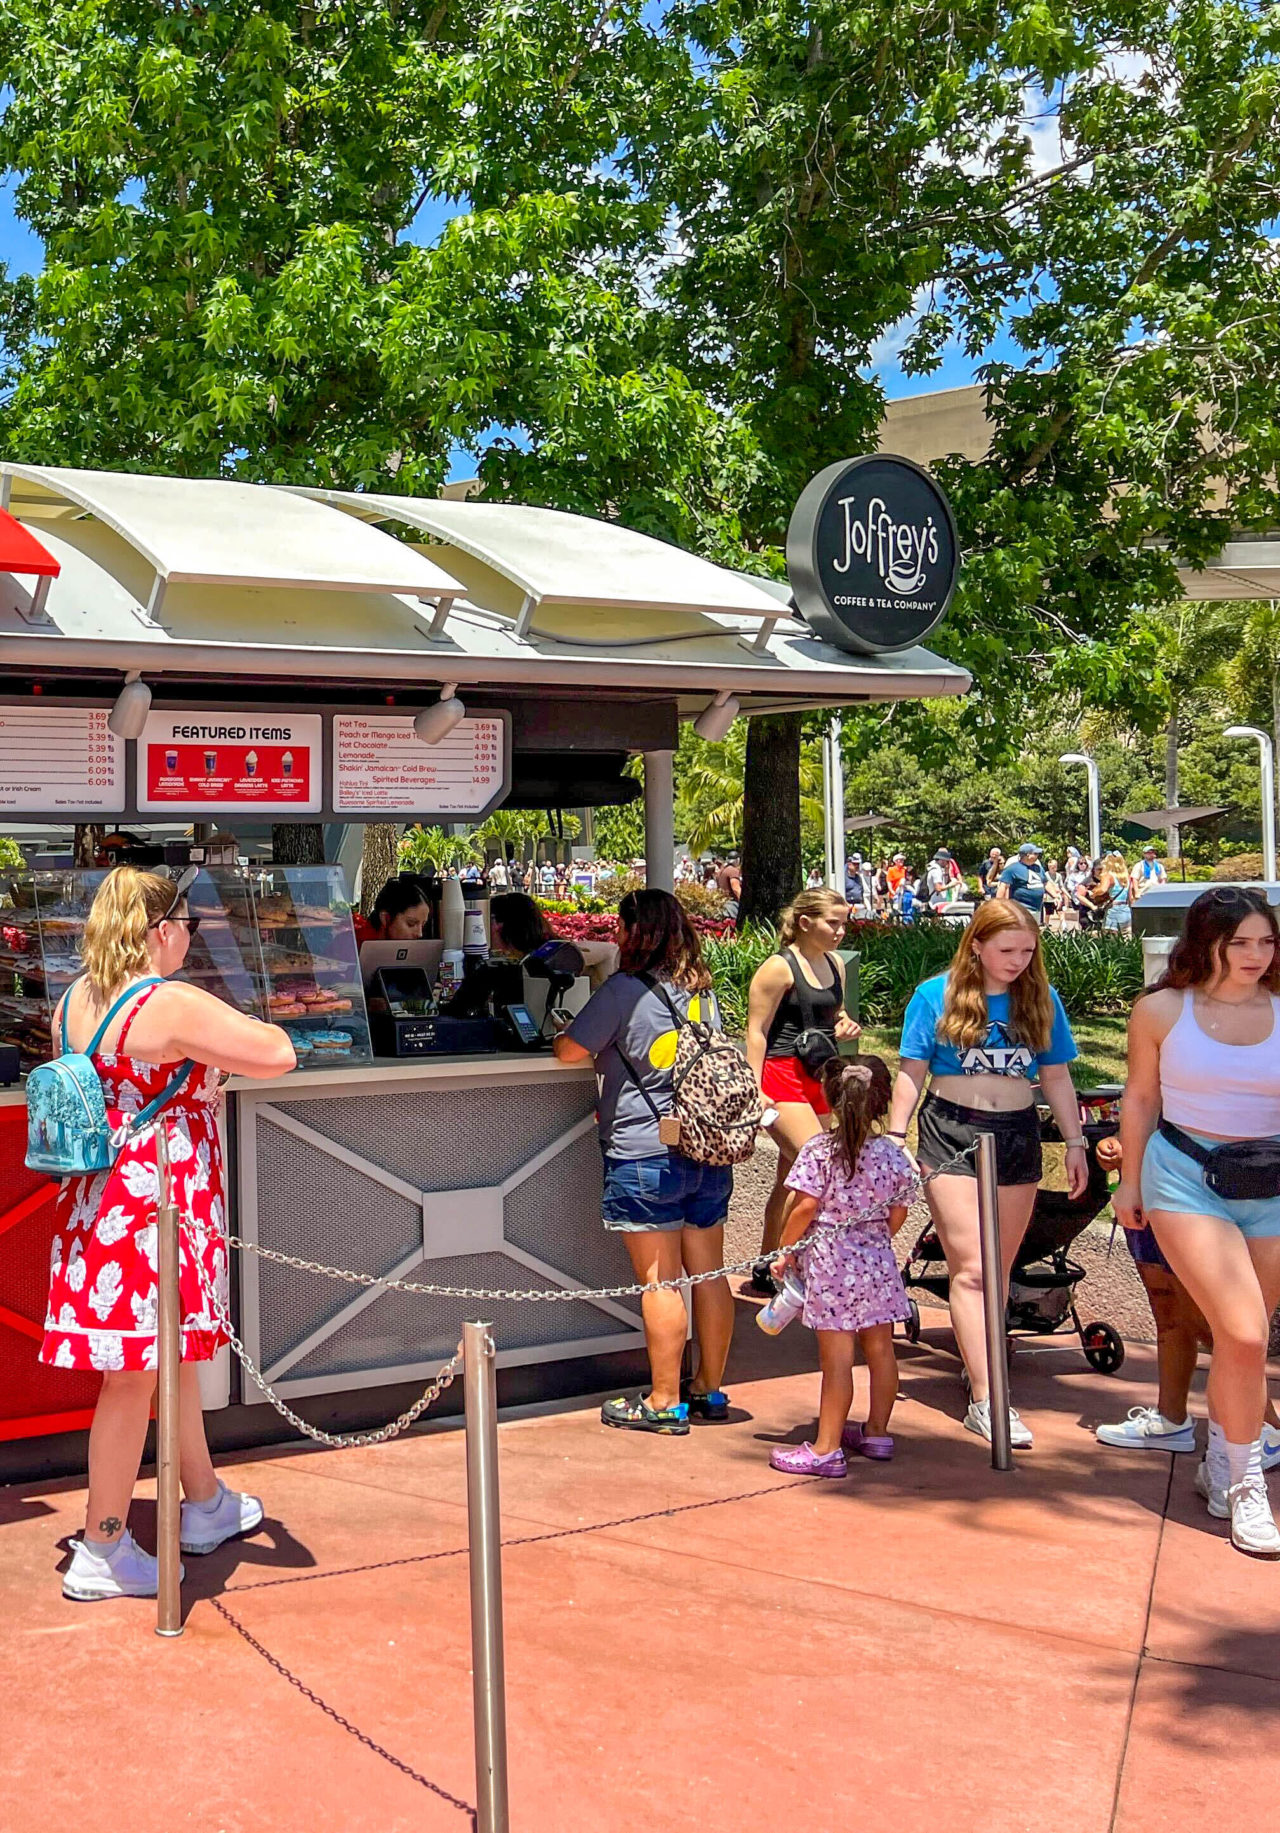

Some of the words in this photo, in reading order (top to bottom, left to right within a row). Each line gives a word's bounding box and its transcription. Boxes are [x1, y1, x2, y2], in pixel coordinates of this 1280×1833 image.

[833, 496, 939, 592] Joffrey's
[834, 595, 867, 607] COFFEE
[868, 598, 875, 608] &
[877, 599, 892, 609] TEA
[88, 712, 107, 720] 3.69
[88, 722, 106, 730] 3.79
[474, 723, 490, 731] 3.69
[88, 733, 107, 742] 5.39
[172, 726, 247, 739] FEATURED
[250, 727, 292, 740] ITEMS
[371, 732, 395, 740] Mango
[474, 733, 491, 741] 4.49
[88, 744, 107, 753] 5.39
[339, 741, 352, 749] Hot
[353, 741, 388, 750] Chocolate
[88, 755, 107, 764] 6.09
[338, 751, 376, 759] Lemonade
[474, 753, 490, 761] 4.99
[88, 766, 107, 775] 6.09
[418, 765, 437, 773] Brew
[474, 765, 490, 773] 5.99
[88, 778, 107, 786] 6.09
[372, 776, 399, 784] Spirited
[400, 776, 436, 785] Beverages
[472, 776, 490, 784] 14.99
[961, 1047, 1033, 1069] ATA
